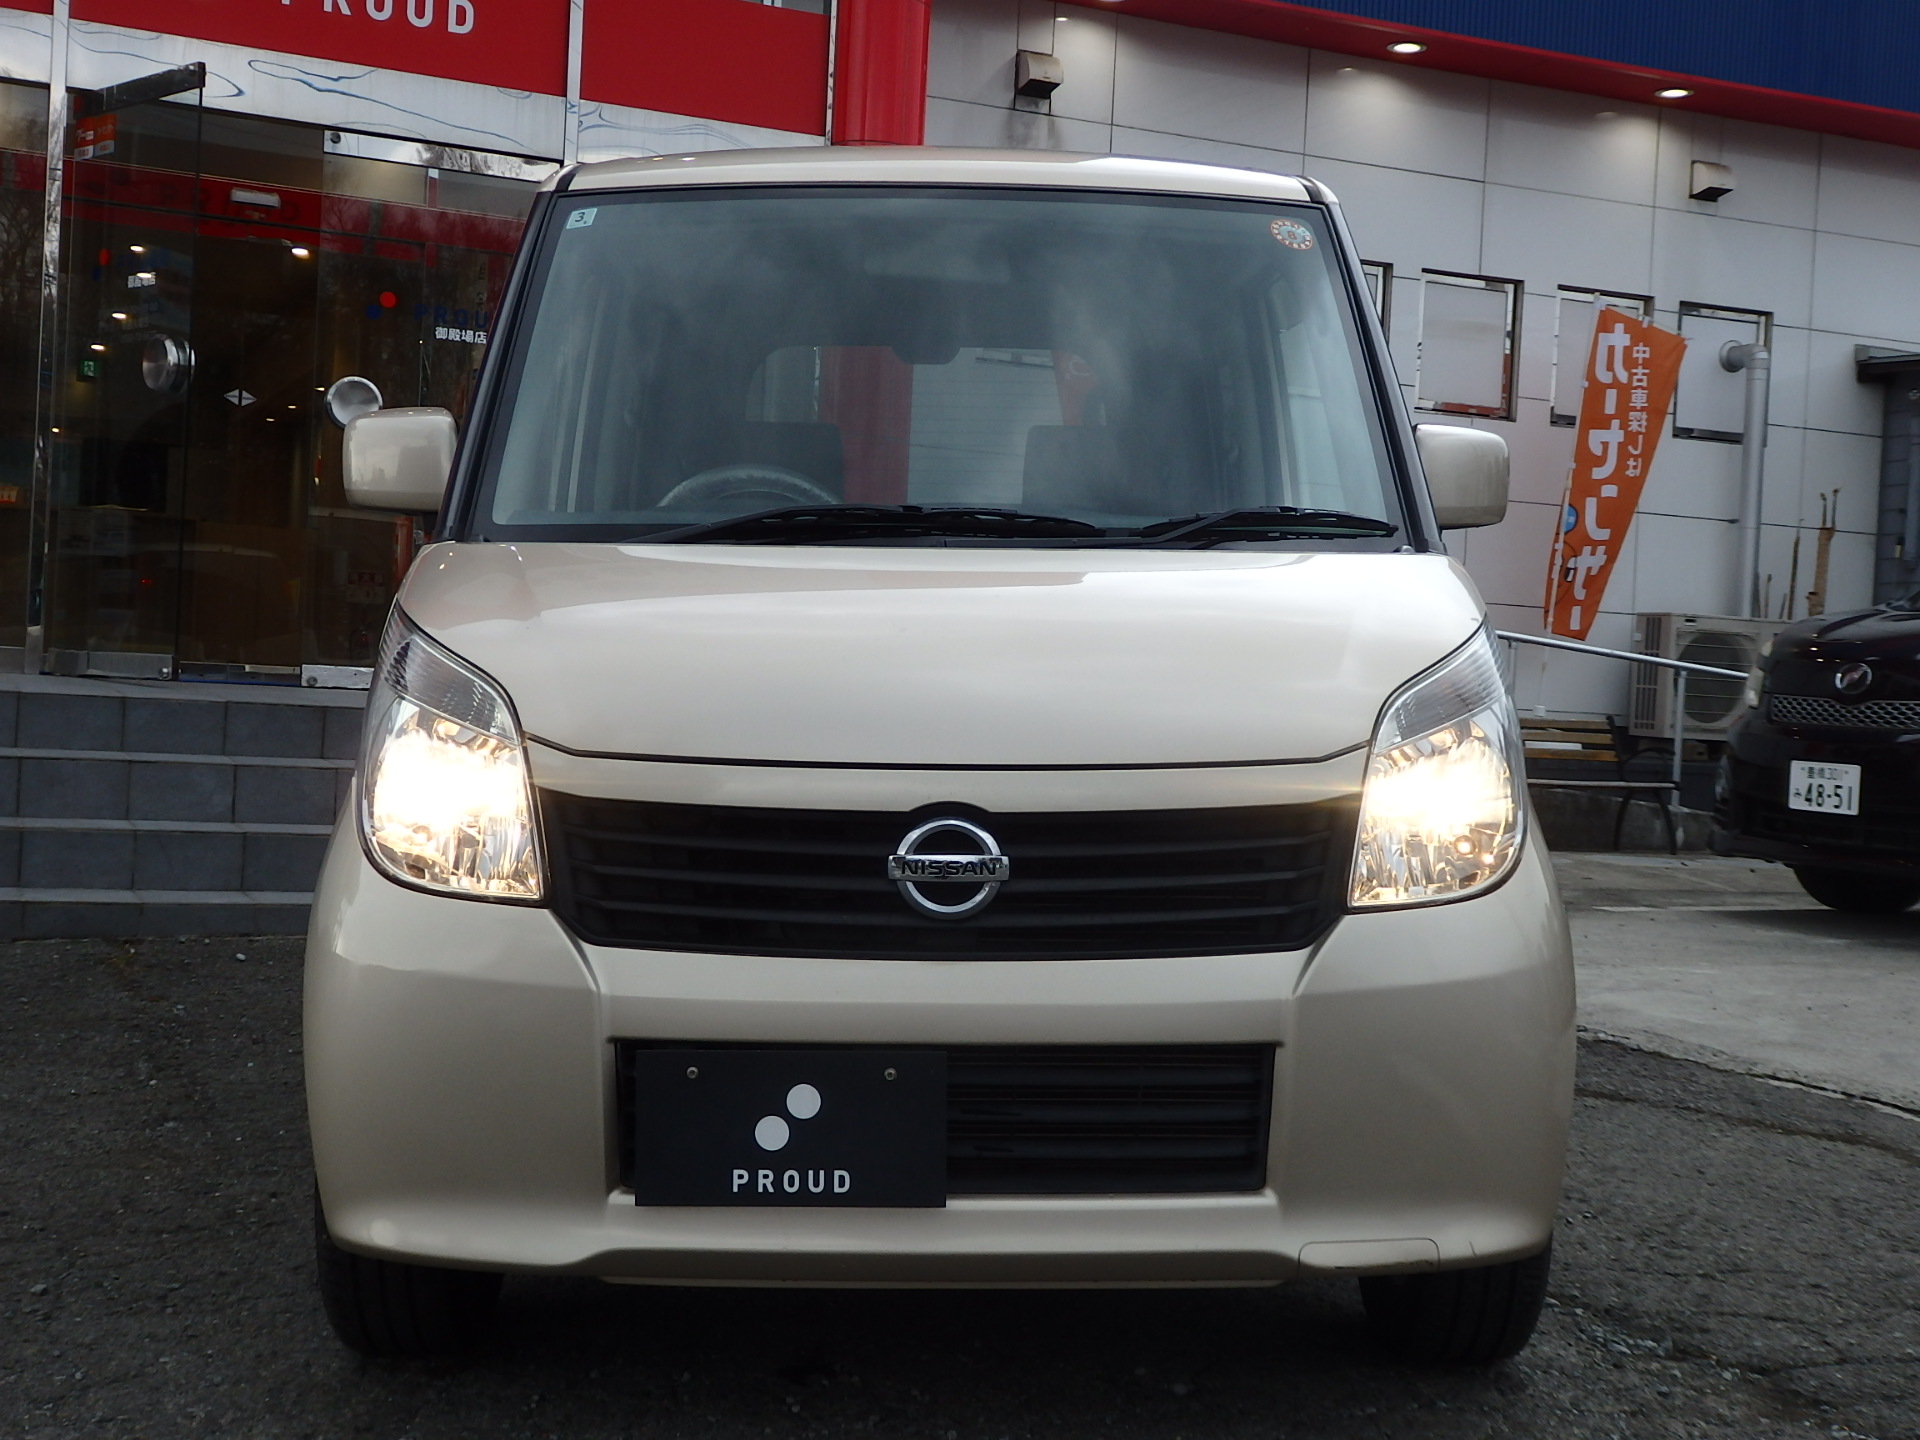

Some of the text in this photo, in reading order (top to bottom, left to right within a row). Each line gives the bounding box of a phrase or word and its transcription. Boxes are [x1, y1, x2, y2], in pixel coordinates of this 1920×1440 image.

[281, 0, 474, 34] OUD
[435, 326, 487, 344] 御殿場店
[901, 859, 997, 876] NISSAN
[732, 1169, 851, 1193] PROUD
